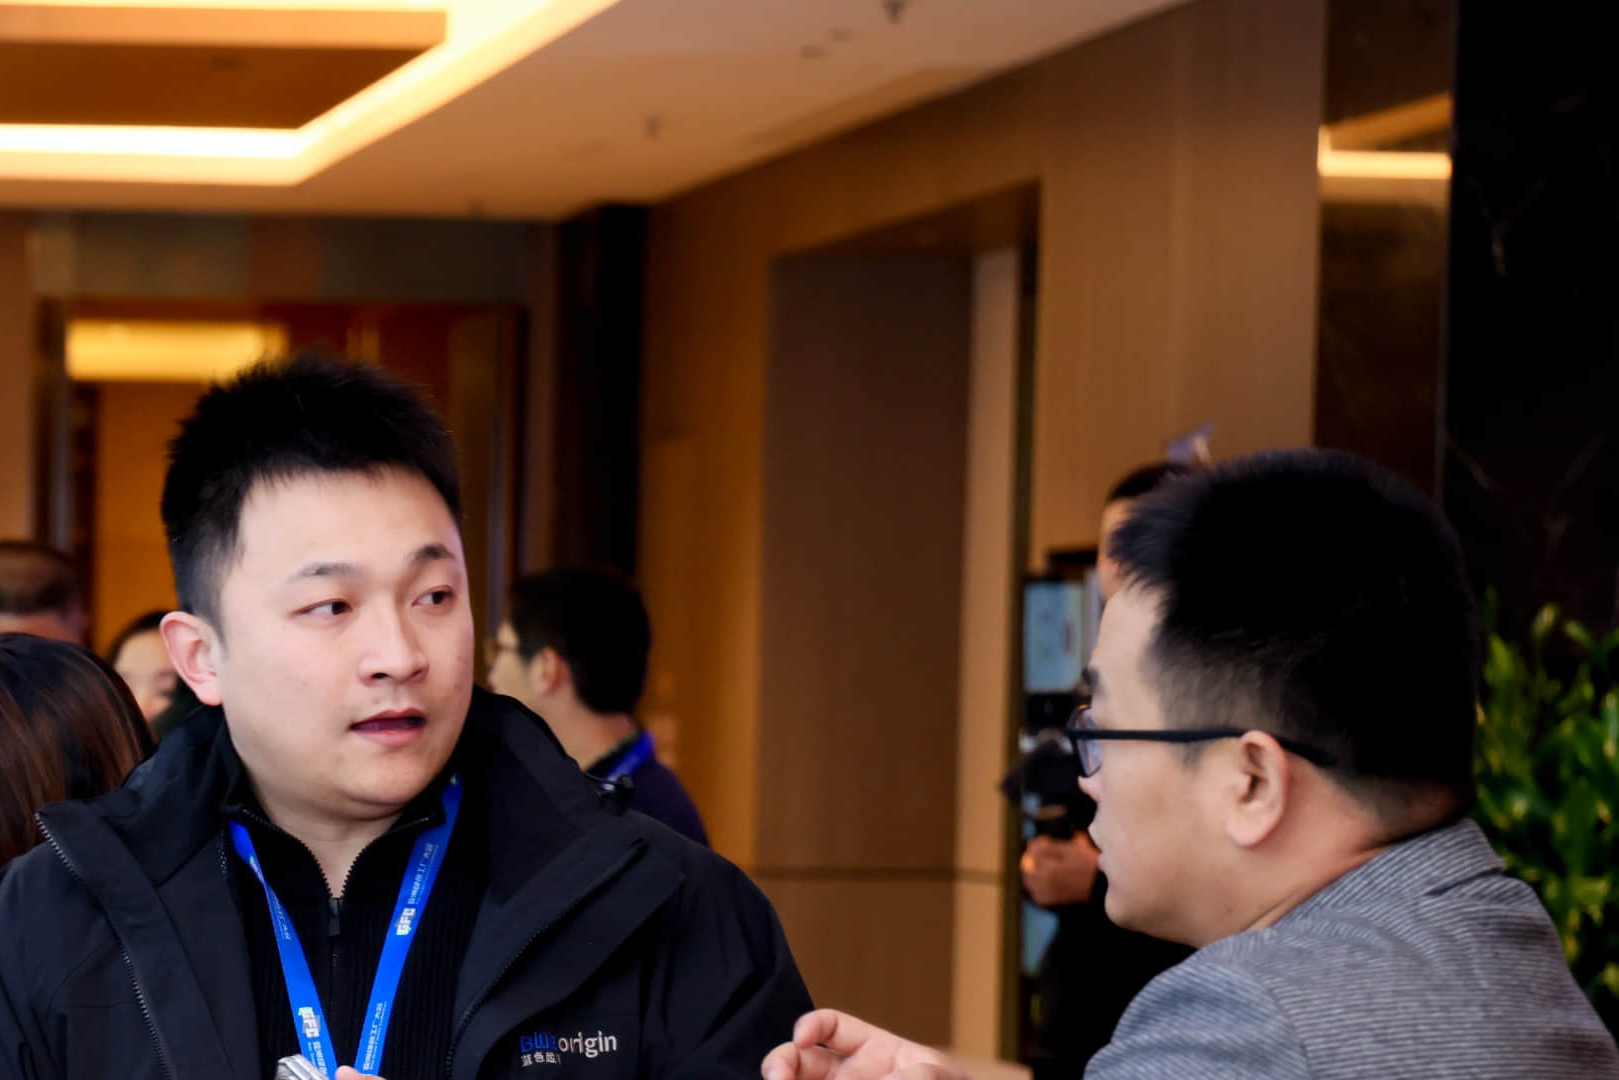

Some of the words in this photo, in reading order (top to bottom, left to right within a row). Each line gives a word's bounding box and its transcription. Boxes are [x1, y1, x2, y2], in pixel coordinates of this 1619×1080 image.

[298, 1006, 320, 1038] GFC
[521, 1051, 561, 1067] 蓝色起
